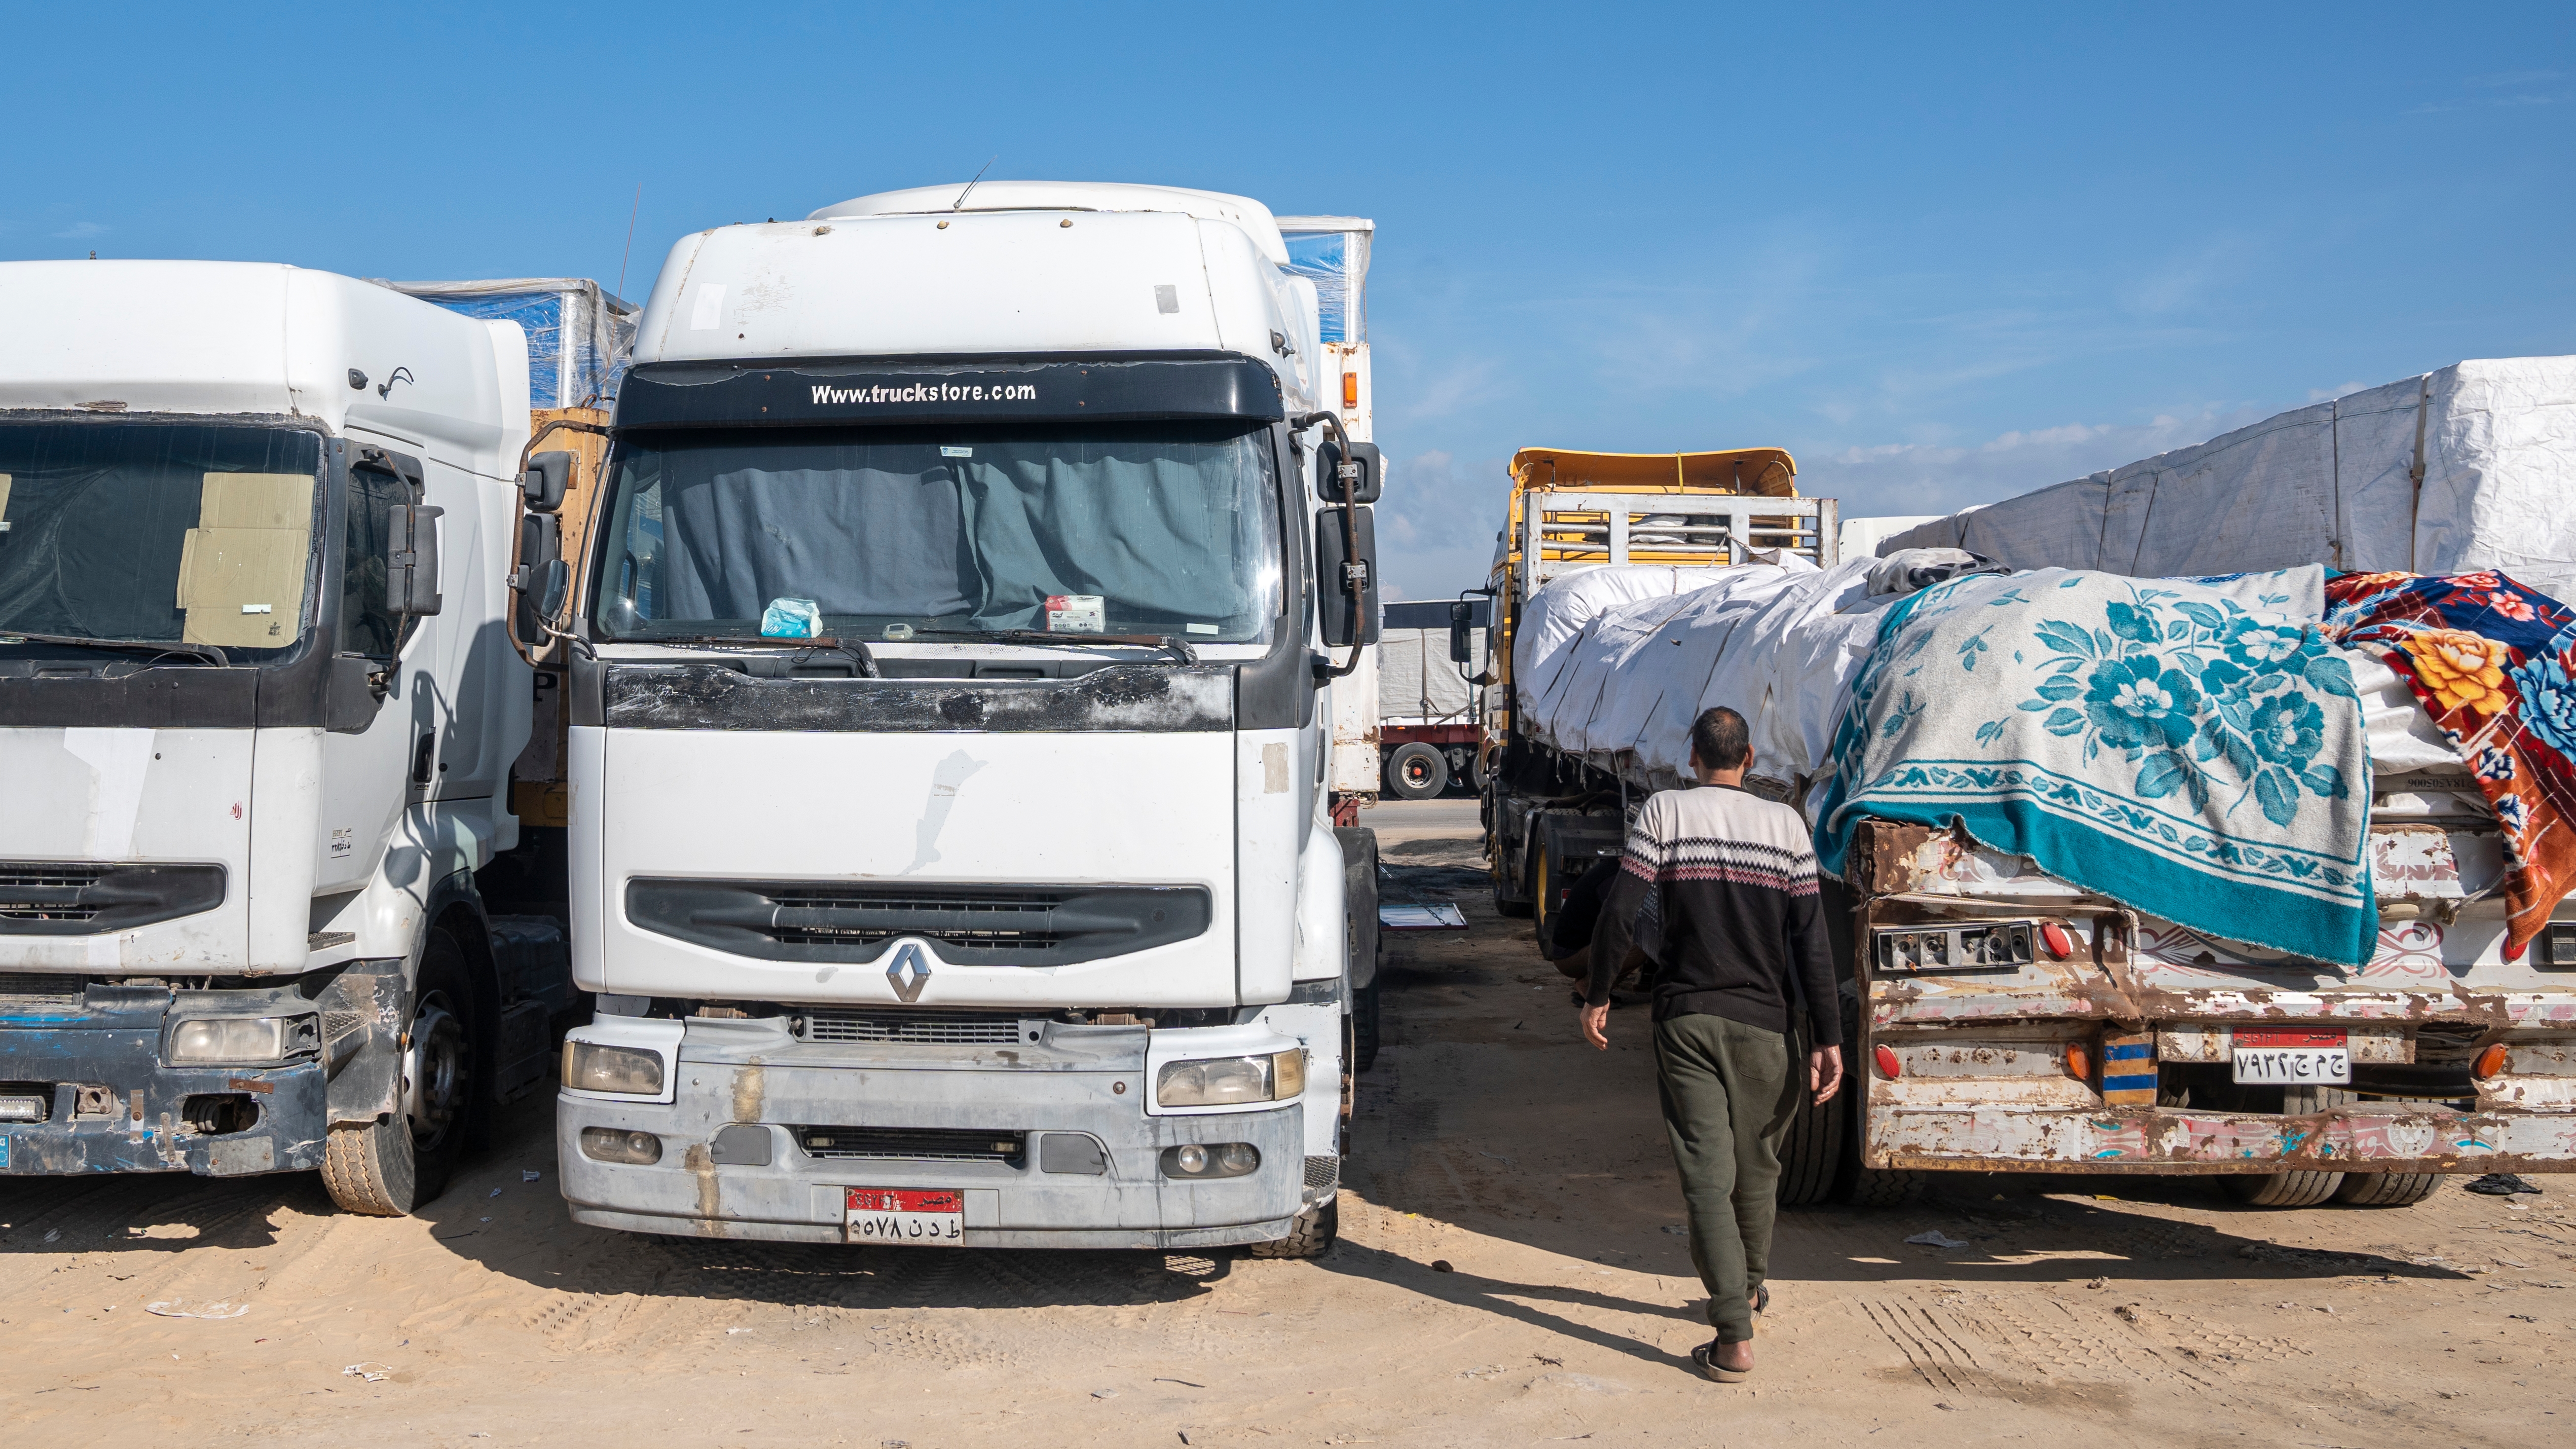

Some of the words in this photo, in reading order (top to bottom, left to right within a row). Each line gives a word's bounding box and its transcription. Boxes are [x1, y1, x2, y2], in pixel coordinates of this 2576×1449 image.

[811, 383, 1036, 404] Www.truckstore.com
[2243, 1031, 2280, 1043] EGYPT
[2303, 1032, 2337, 1043] مصر
[917, 1196, 952, 1207] مصر
